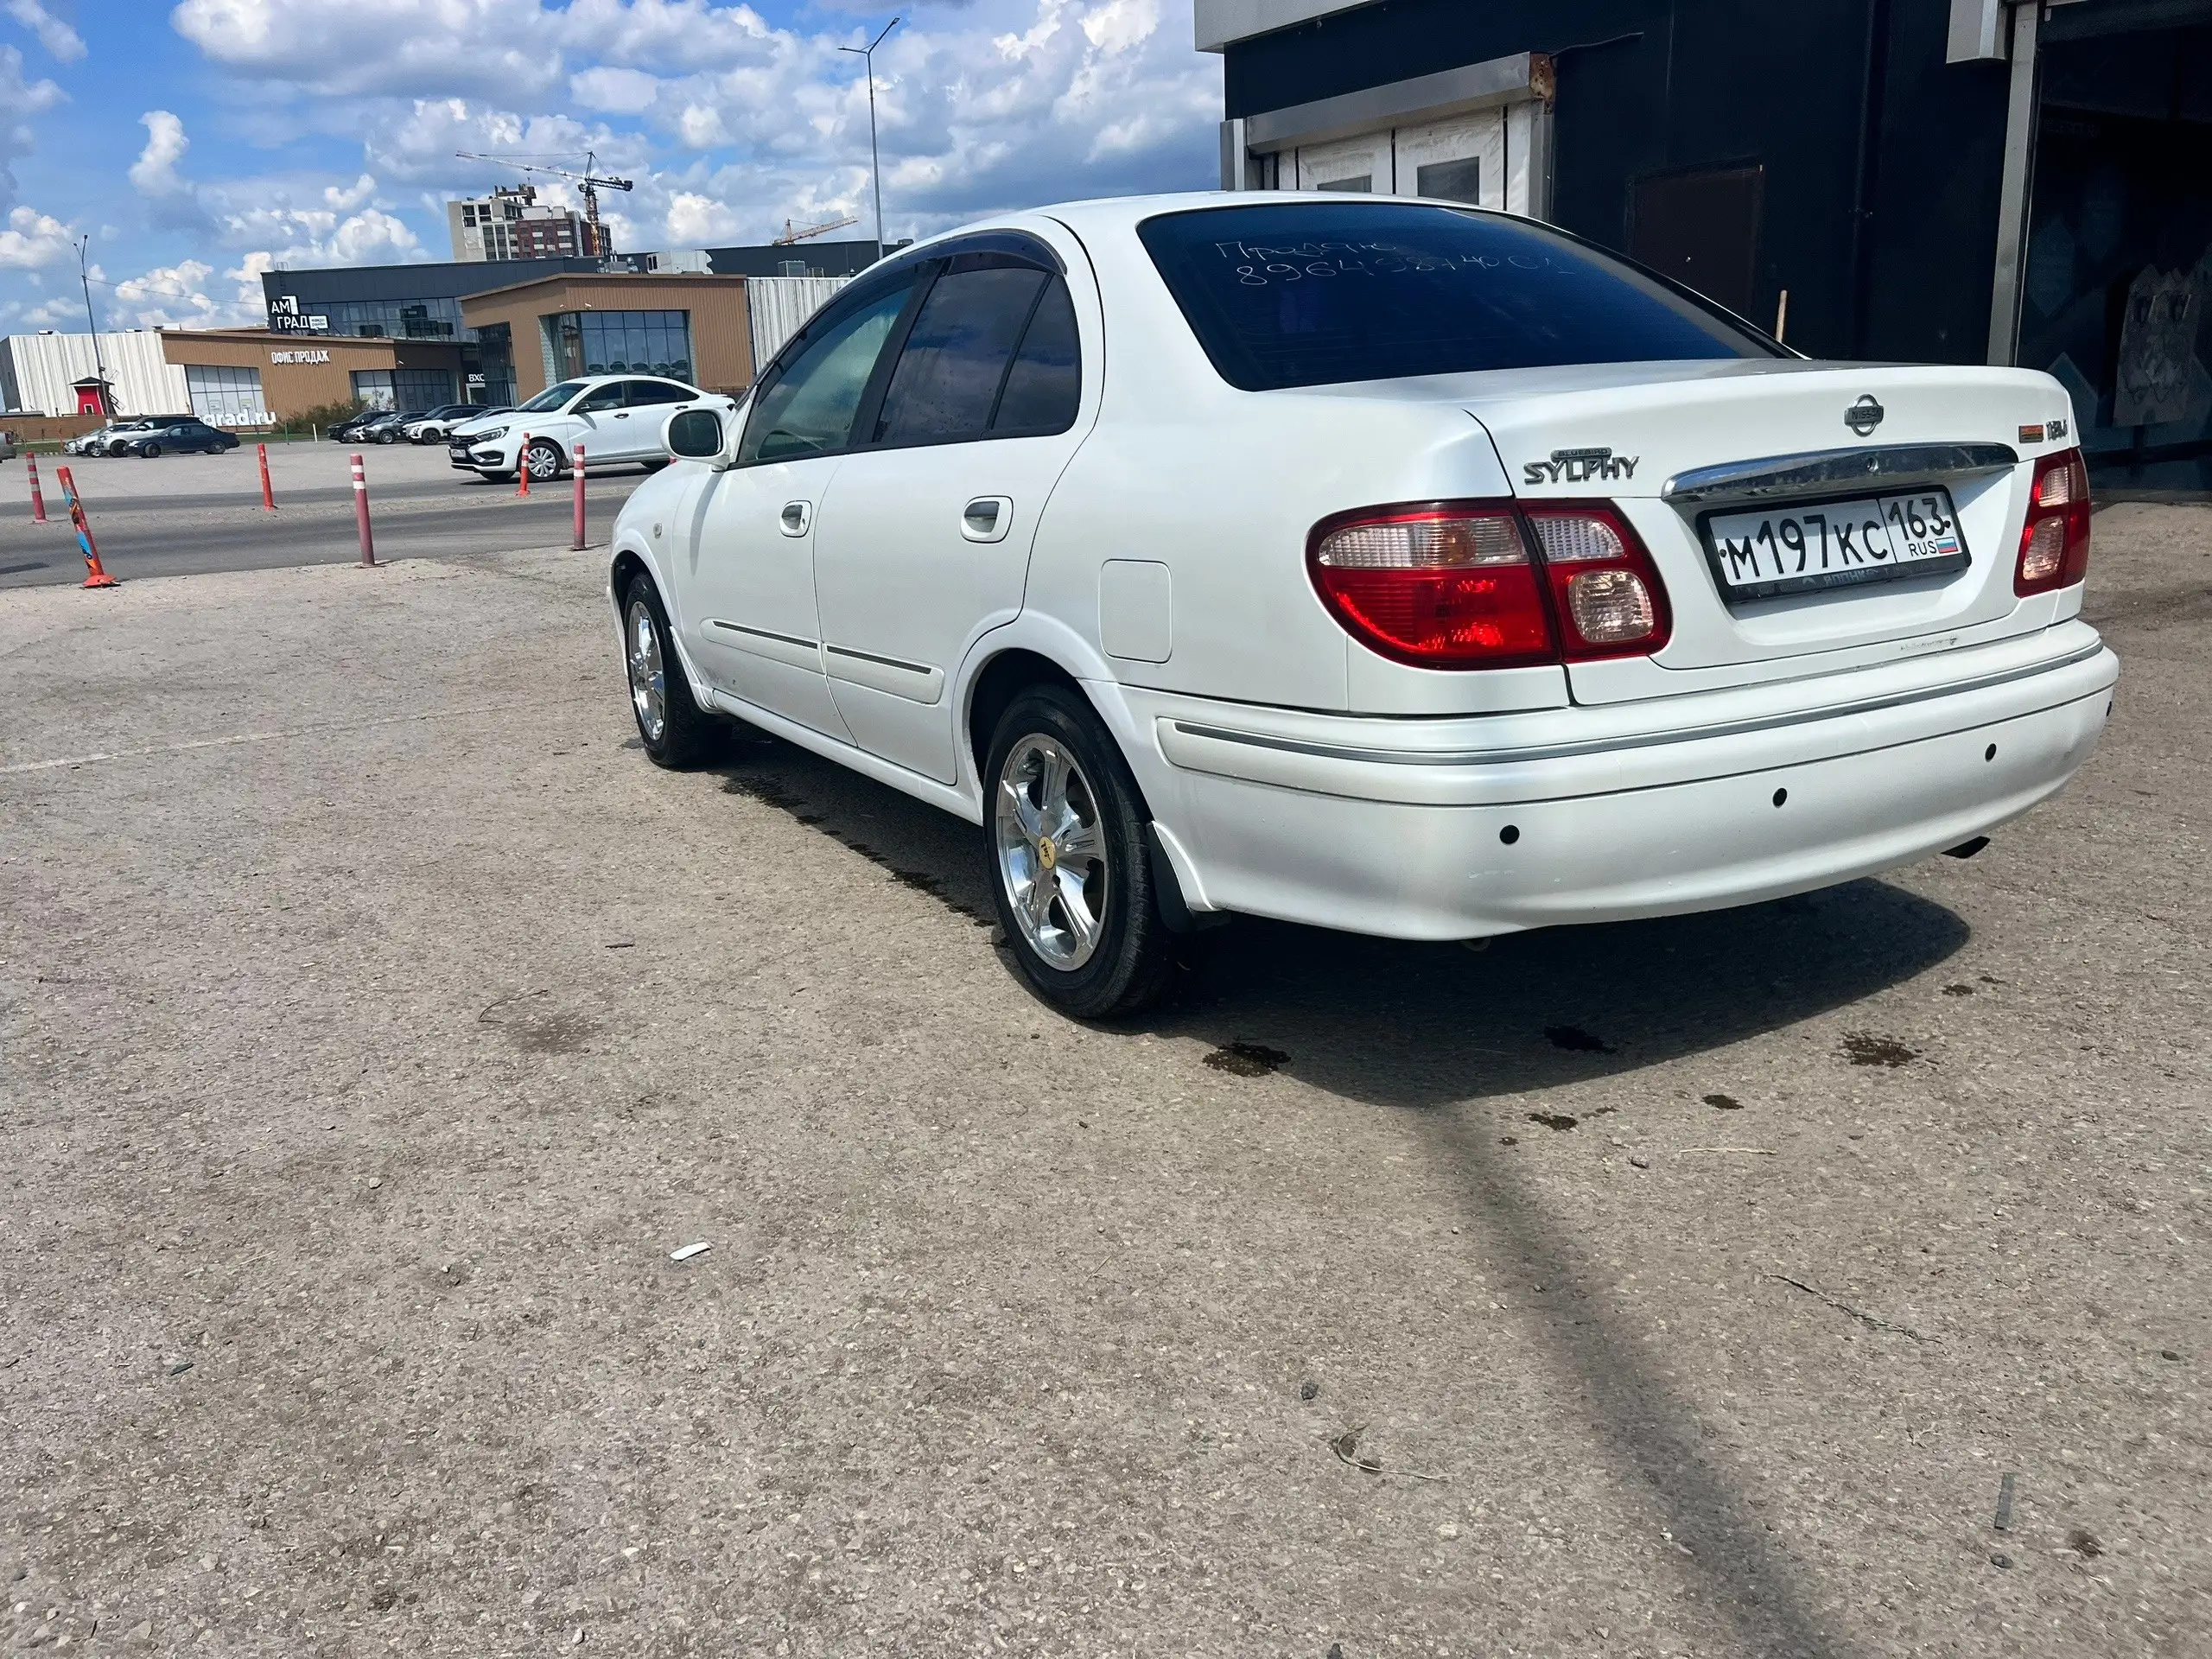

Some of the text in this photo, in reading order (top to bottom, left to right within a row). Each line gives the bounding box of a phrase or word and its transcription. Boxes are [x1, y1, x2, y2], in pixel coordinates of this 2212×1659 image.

[271, 300, 291, 314] АМ
[276, 315, 310, 329] ГРАД
[271, 350, 330, 365] ОФИС ПРОДАЖ
[1523, 455, 1640, 486] SYLPHY
[1725, 498, 1946, 581] М197КС 163
[1908, 540, 1937, 557] RUS
